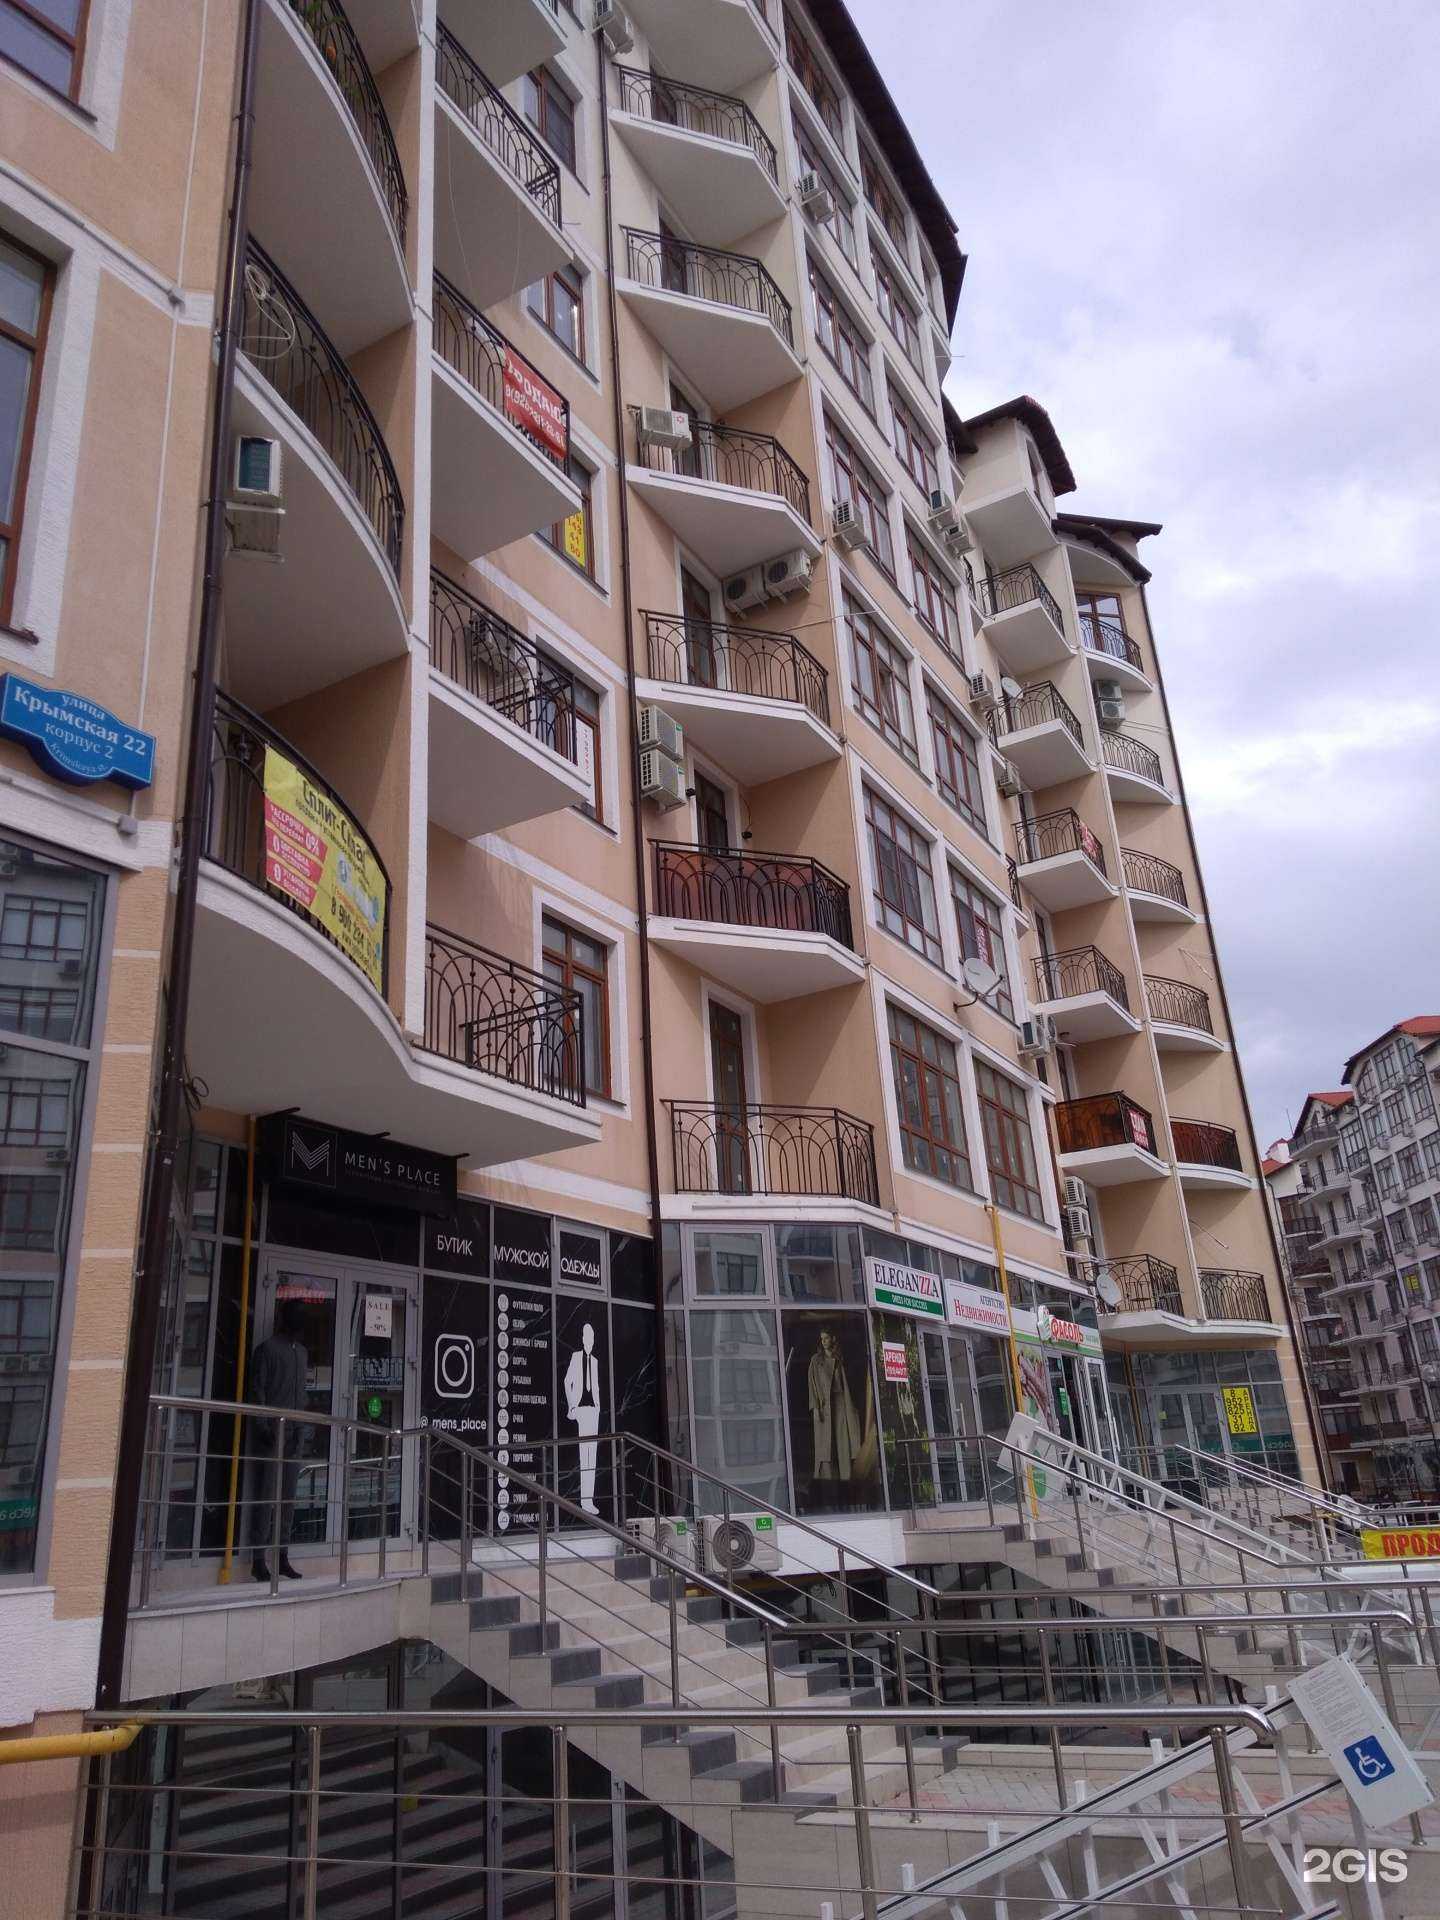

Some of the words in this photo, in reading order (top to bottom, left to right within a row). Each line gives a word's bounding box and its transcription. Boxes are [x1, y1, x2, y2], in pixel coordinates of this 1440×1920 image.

[14, 686, 119, 745] Крымская
[123, 734, 147, 756] 22
[62, 694, 105, 721] улица
[45, 722, 101, 754] корпус
[104, 745, 114, 760] 2
[344, 1151, 392, 1175] MEN'S
[397, 1164, 441, 1186] PLACE
[436, 1234, 473, 1257] БУТИК
[494, 1244, 550, 1269] МУЖСКОЙ
[560, 1257, 600, 1279] ОДЕЖДЫ
[873, 1263, 940, 1298] ELEGANZZA
[367, 1301, 390, 1311] SALE
[1050, 1317, 1084, 1344] ФАСОЛЬ
[1230, 1389, 1236, 1398] 8
[1243, 1389, 1255, 1431] АРЕНДА
[432, 1416, 488, 1432] mens_place
